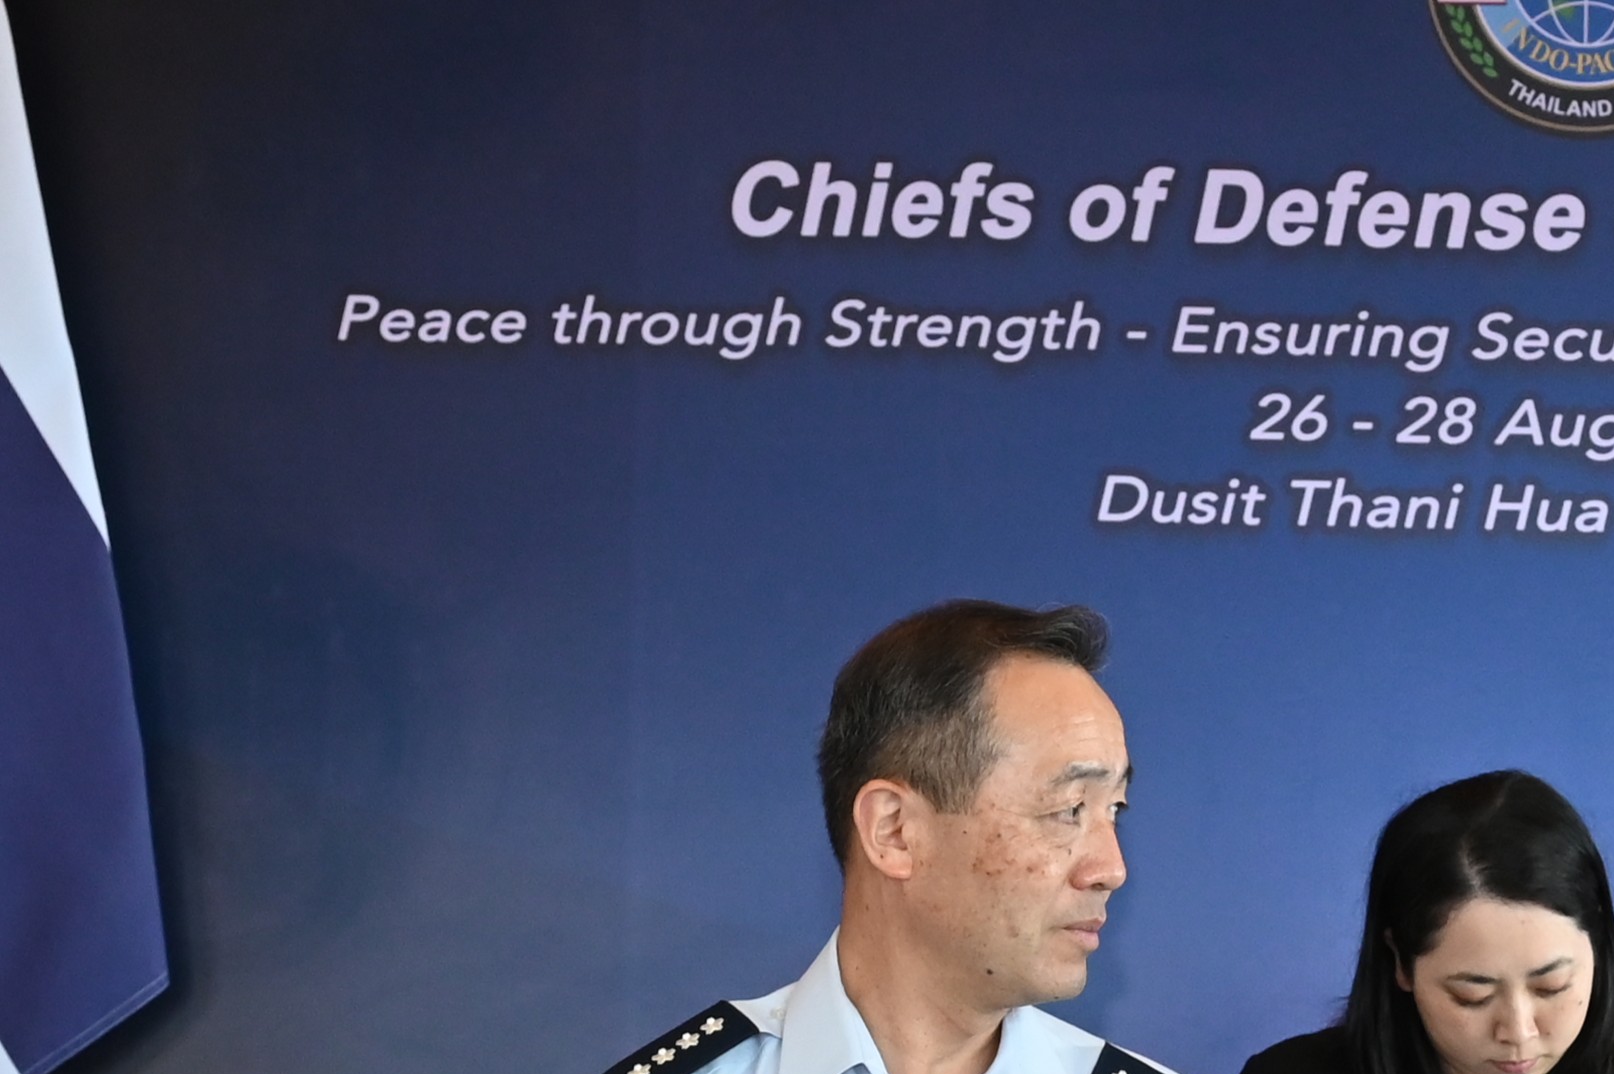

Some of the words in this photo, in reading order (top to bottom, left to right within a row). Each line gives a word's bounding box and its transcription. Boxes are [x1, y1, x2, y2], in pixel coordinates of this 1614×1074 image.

[1508, 78, 1613, 118] THAILAND
[732, 161, 1034, 240] Chiefs
[1070, 167, 1175, 242] of
[1195, 169, 1586, 252] Defense
[338, 294, 527, 343] Peace
[552, 294, 801, 360] through
[825, 299, 1101, 363] Strength
[1126, 330, 1147, 340] -
[1172, 306, 1450, 372] Ensuring
[1249, 392, 1328, 442] 26
[1352, 421, 1374, 430] -
[1395, 396, 1477, 445] 28
[1097, 474, 1267, 526] Dusit
[1290, 477, 1464, 530] Thani
[1484, 483, 1609, 533] Hua
